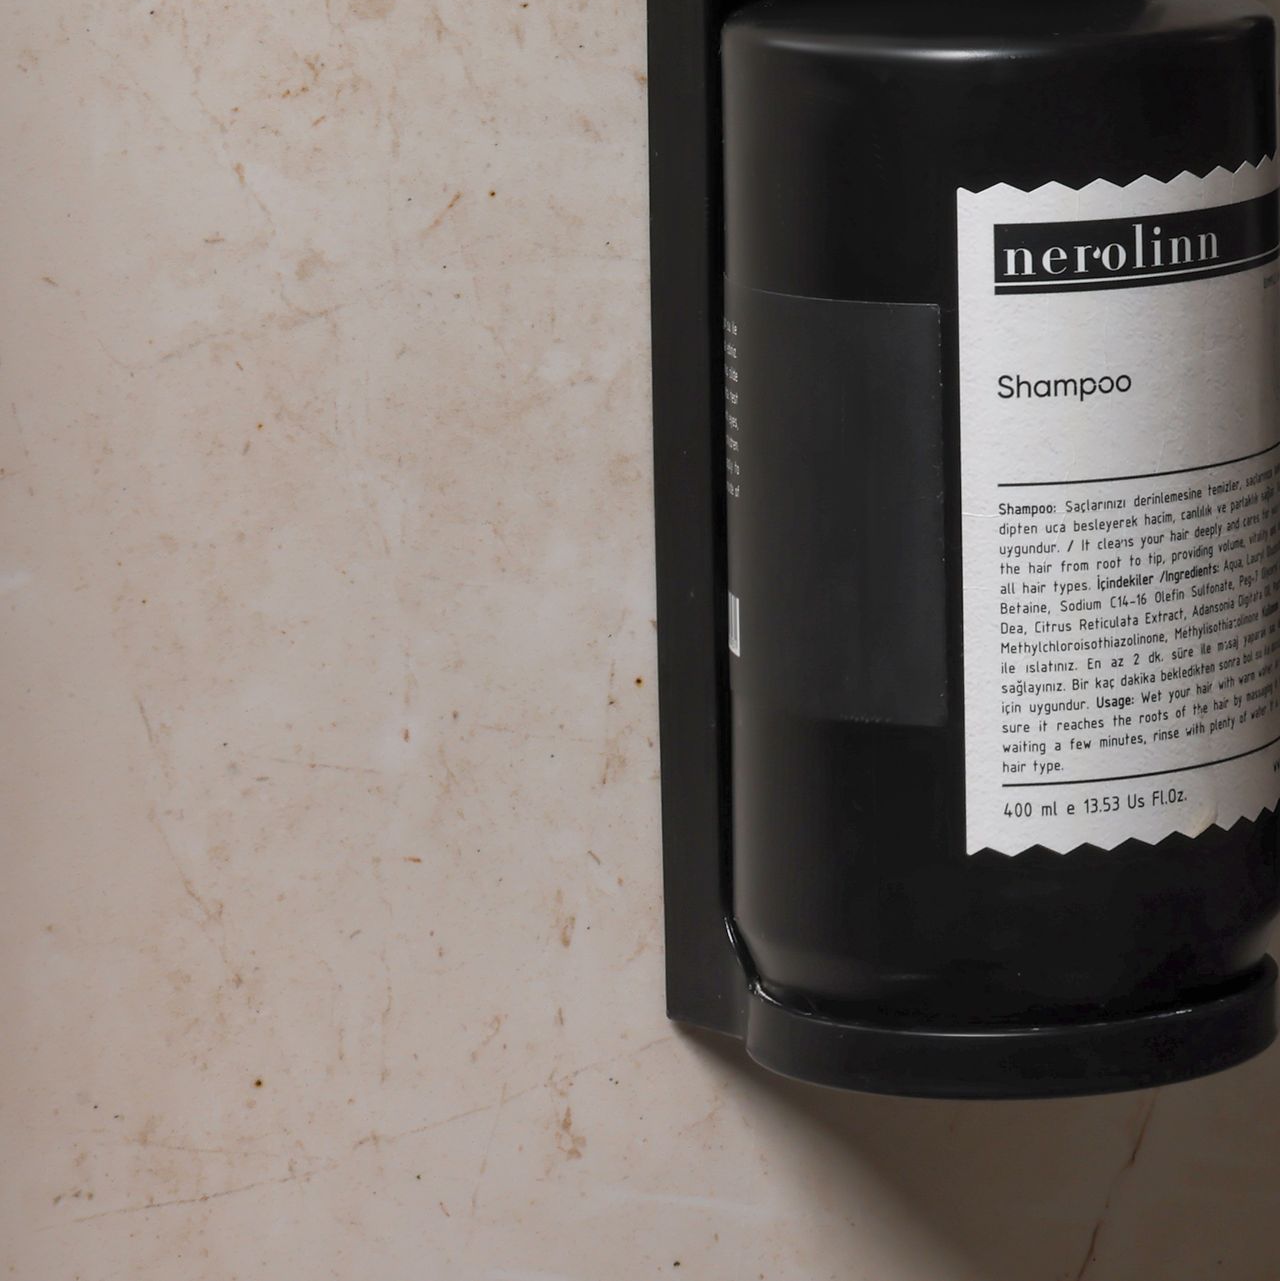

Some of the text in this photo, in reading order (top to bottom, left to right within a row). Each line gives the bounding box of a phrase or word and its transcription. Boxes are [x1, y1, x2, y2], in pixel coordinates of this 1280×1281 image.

[1003, 223, 1220, 277] nerolinn
[998, 374, 1132, 402] Shampoo
[998, 502, 1057, 518] Shampoo:
[999, 515, 1138, 538] dipten uca besleyerek
[999, 533, 1165, 559] uygundur. It your
[1000, 560, 1089, 575] the hair from
[1000, 582, 1016, 595] all
[1022, 581, 1046, 594] hair
[1053, 580, 1091, 596] types.
[1000, 592, 1147, 615] Betaine, Sodium C14-16
[1000, 614, 1139, 636] Dea, Citrus Reticulata
[1001, 662, 1016, 674] ile
[1087, 657, 1102, 670] En
[1072, 678, 1089, 691] Bir
[1029, 698, 1089, 716] uygundur.
[1096, 695, 1135, 710] Usage:
[1002, 717, 1105, 734] sure it reaches
[1002, 737, 1092, 756] waiting a few
[1002, 760, 1064, 776] hair type.
[1003, 787, 1188, 818] 400 ml e 13.53 Us Fl.Oz.
